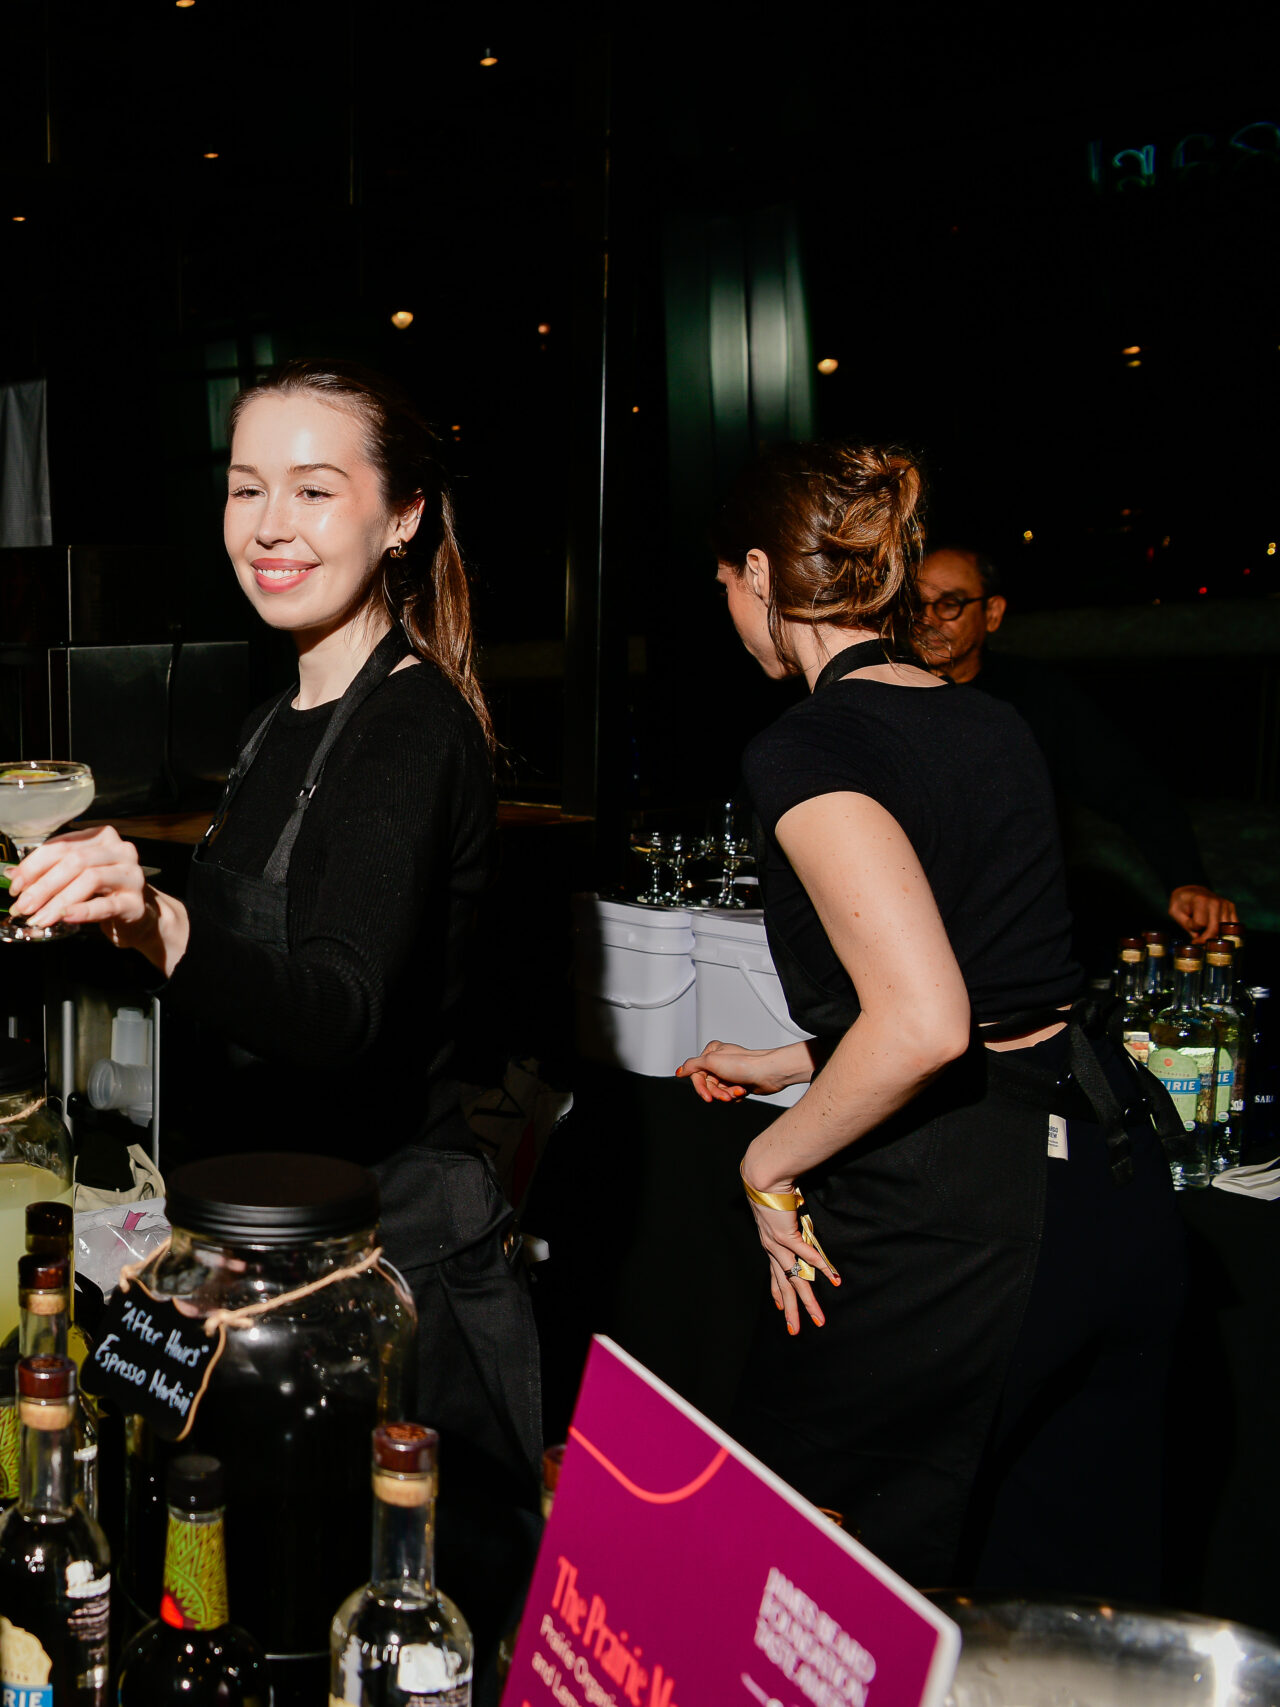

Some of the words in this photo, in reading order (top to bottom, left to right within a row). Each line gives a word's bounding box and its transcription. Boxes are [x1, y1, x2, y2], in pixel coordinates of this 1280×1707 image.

[95, 1333, 147, 1385] Espresso
[149, 1369, 194, 1416] Martini
[540, 1614, 576, 1670] Prairie
[552, 1556, 587, 1635] The
[583, 1595, 648, 1707] Prairie
